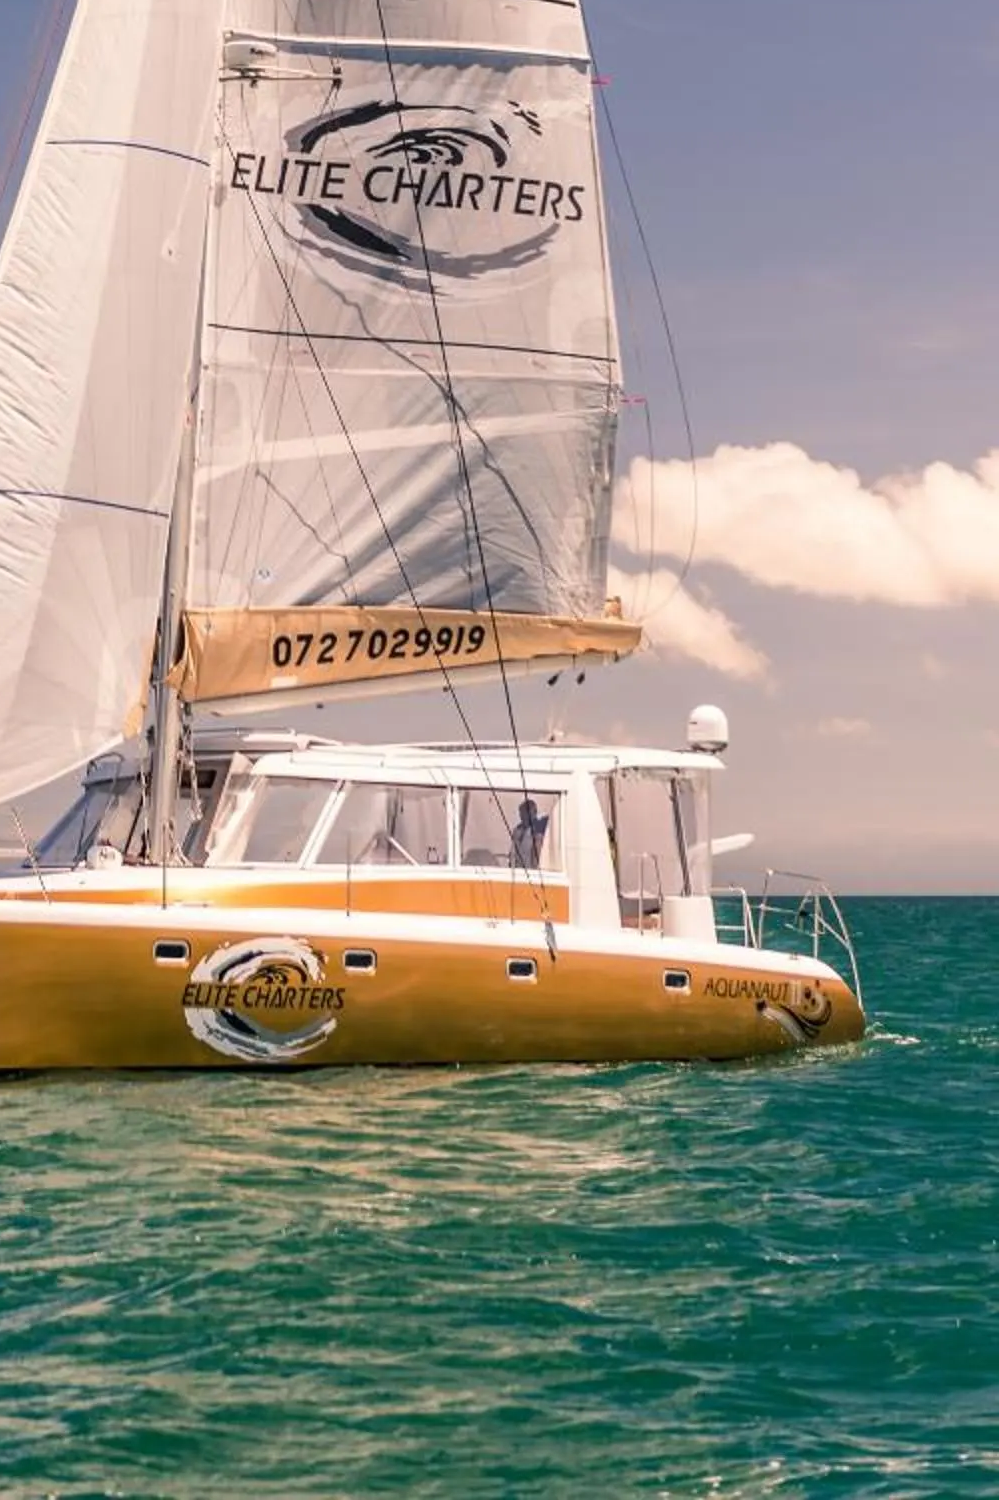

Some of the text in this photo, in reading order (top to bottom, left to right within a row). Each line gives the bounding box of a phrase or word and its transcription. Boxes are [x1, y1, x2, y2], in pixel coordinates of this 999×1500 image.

[231, 153, 584, 222] ELITE CHARTERS
[182, 983, 346, 1010] ELITE CHARTERS
[704, 977, 790, 1001] AQUANAUT
